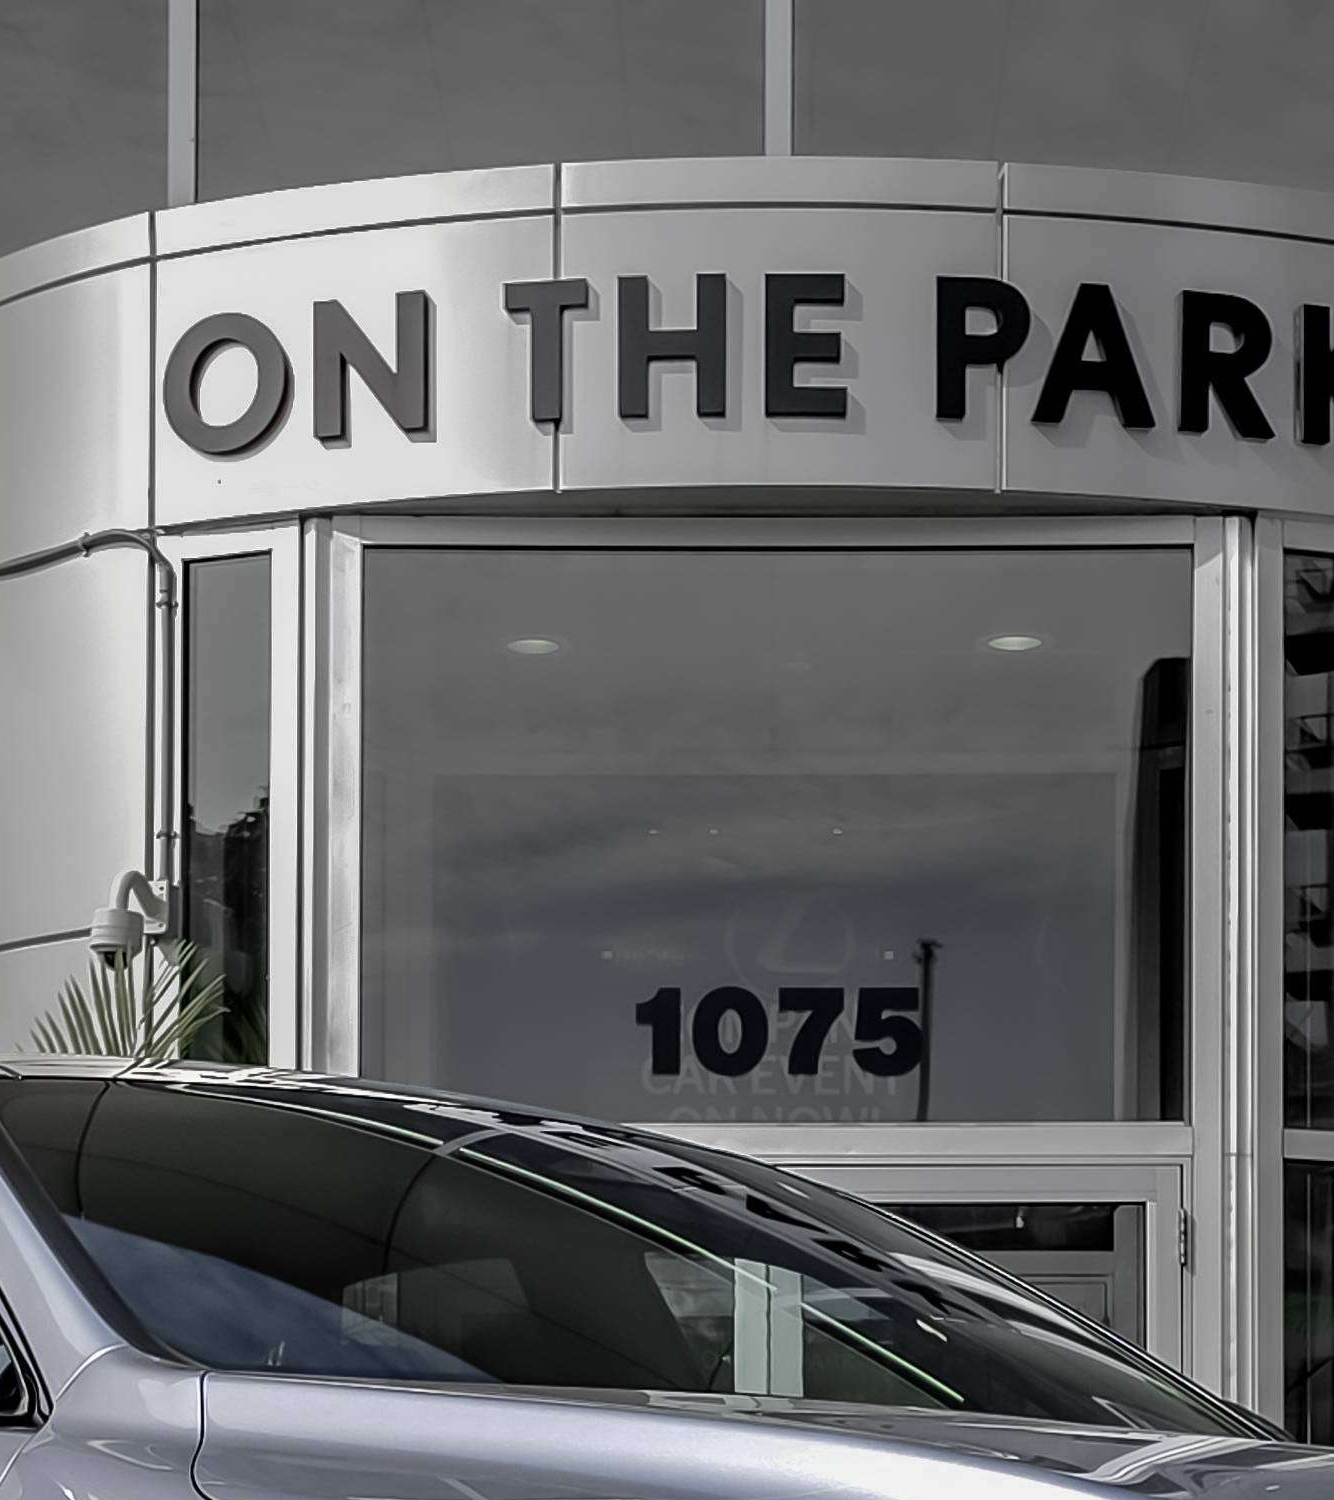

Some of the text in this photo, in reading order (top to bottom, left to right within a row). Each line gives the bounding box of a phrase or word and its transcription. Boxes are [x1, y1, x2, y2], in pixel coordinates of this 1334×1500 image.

[163, 288, 437, 460] ON
[503, 273, 853, 425] THE
[635, 985, 925, 1078] 1075
